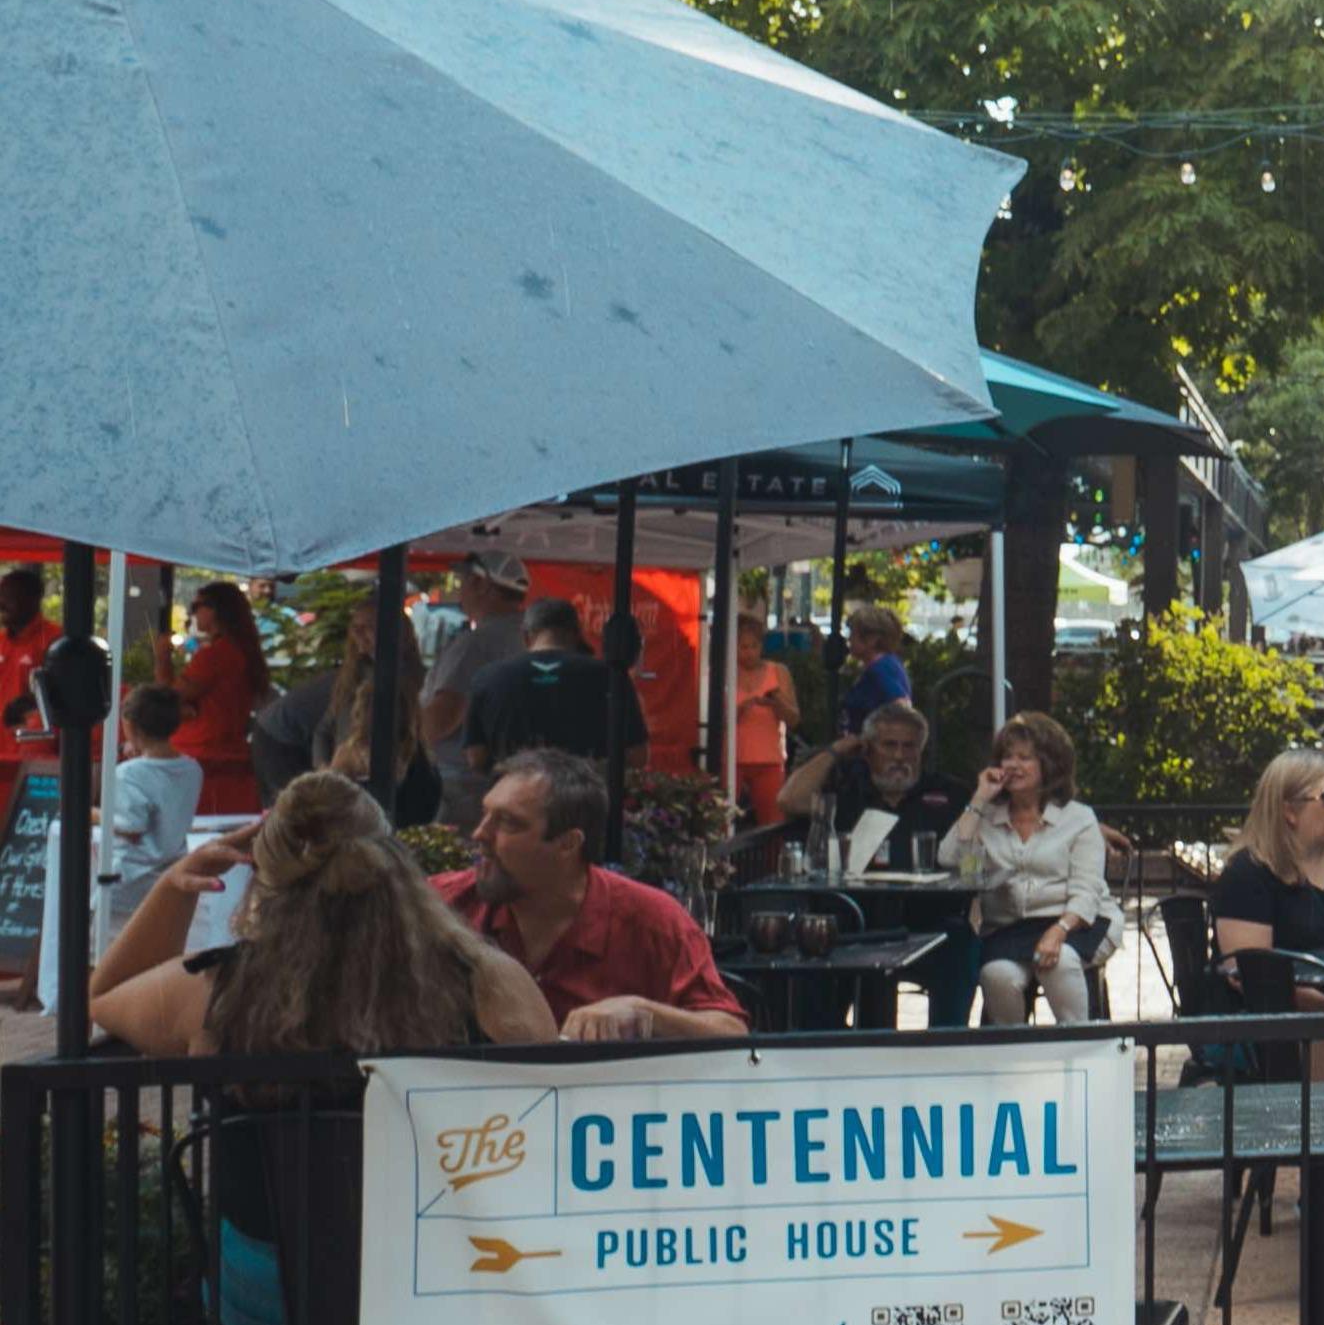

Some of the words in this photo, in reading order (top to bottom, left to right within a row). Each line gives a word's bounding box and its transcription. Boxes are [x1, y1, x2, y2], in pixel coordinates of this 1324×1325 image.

[702, 471, 827, 495] ETATE
[437, 1114, 526, 1192] The
[570, 1102, 1078, 1191] CENTENNIAL
[597, 1224, 747, 1269] PUBLIC
[787, 1219, 919, 1260] HOUSE
